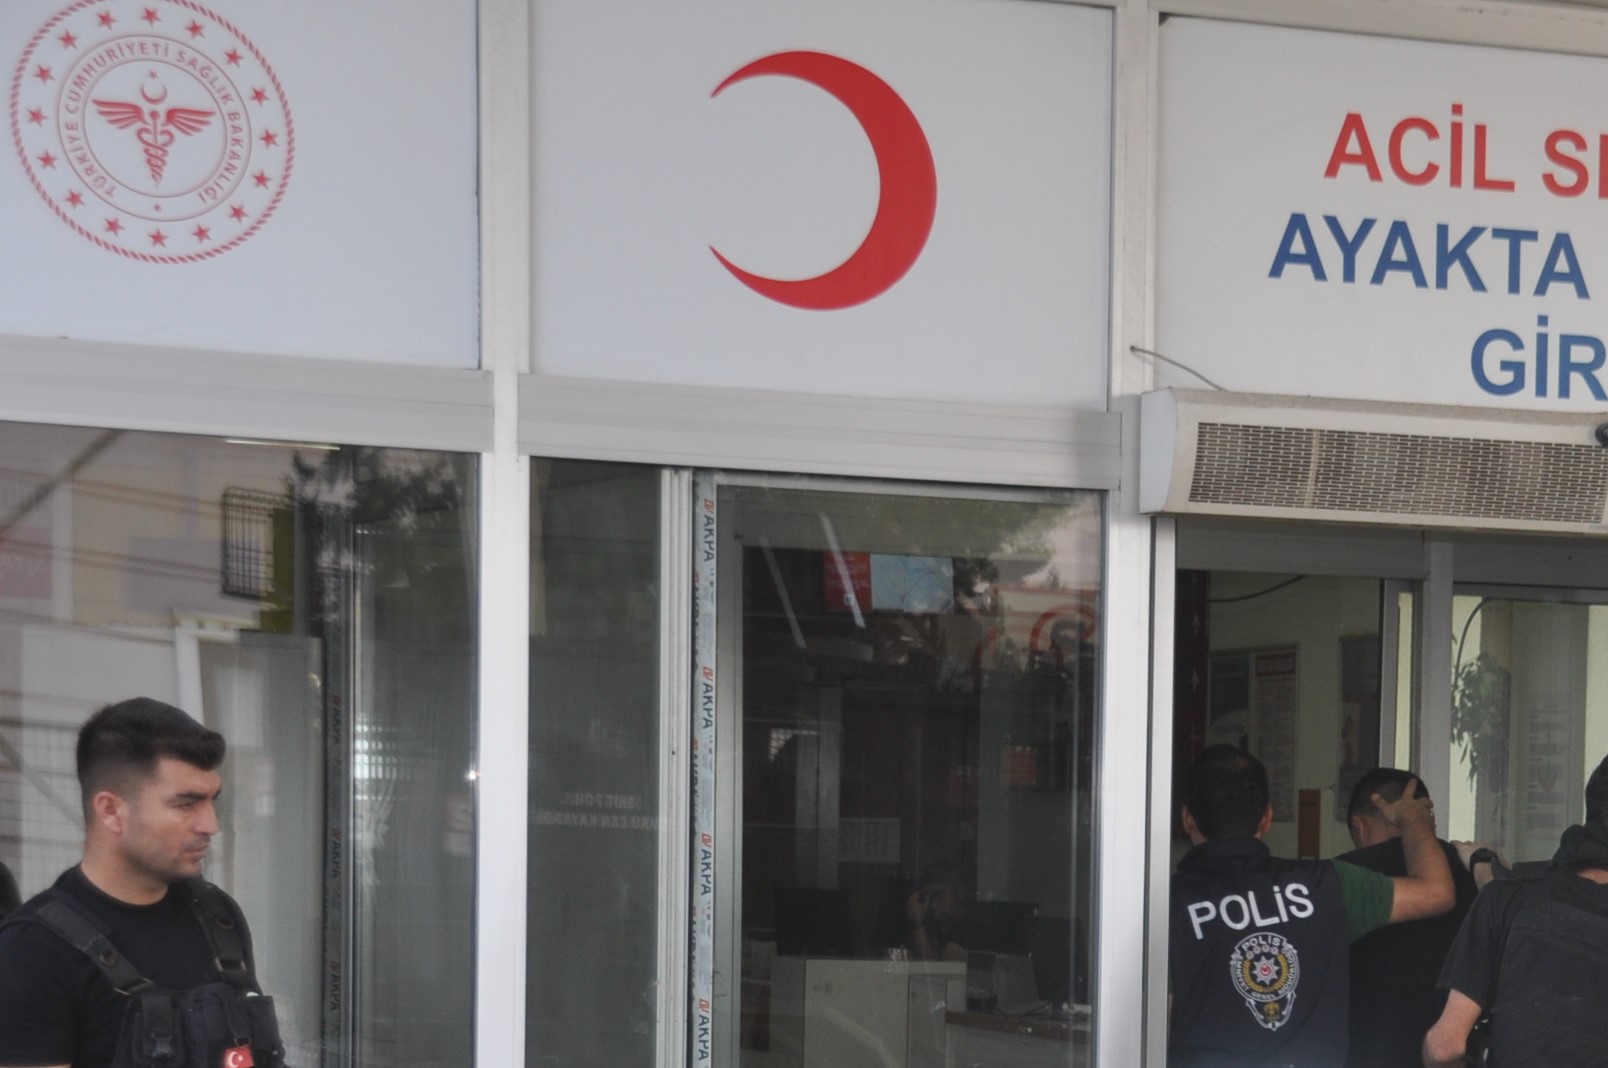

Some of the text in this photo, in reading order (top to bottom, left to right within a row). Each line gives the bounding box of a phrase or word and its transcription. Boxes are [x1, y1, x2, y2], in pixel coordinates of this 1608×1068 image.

[65, 41, 244, 204] TÜRKİYE CUMHURİYETİ SAĞLIK BAKANLIĞI
[1323, 103, 1515, 193] ACİL
[1267, 212, 1591, 300] AYAKTA
[1187, 882, 1315, 940] POLİS
[1241, 934, 1281, 951] POLİS
